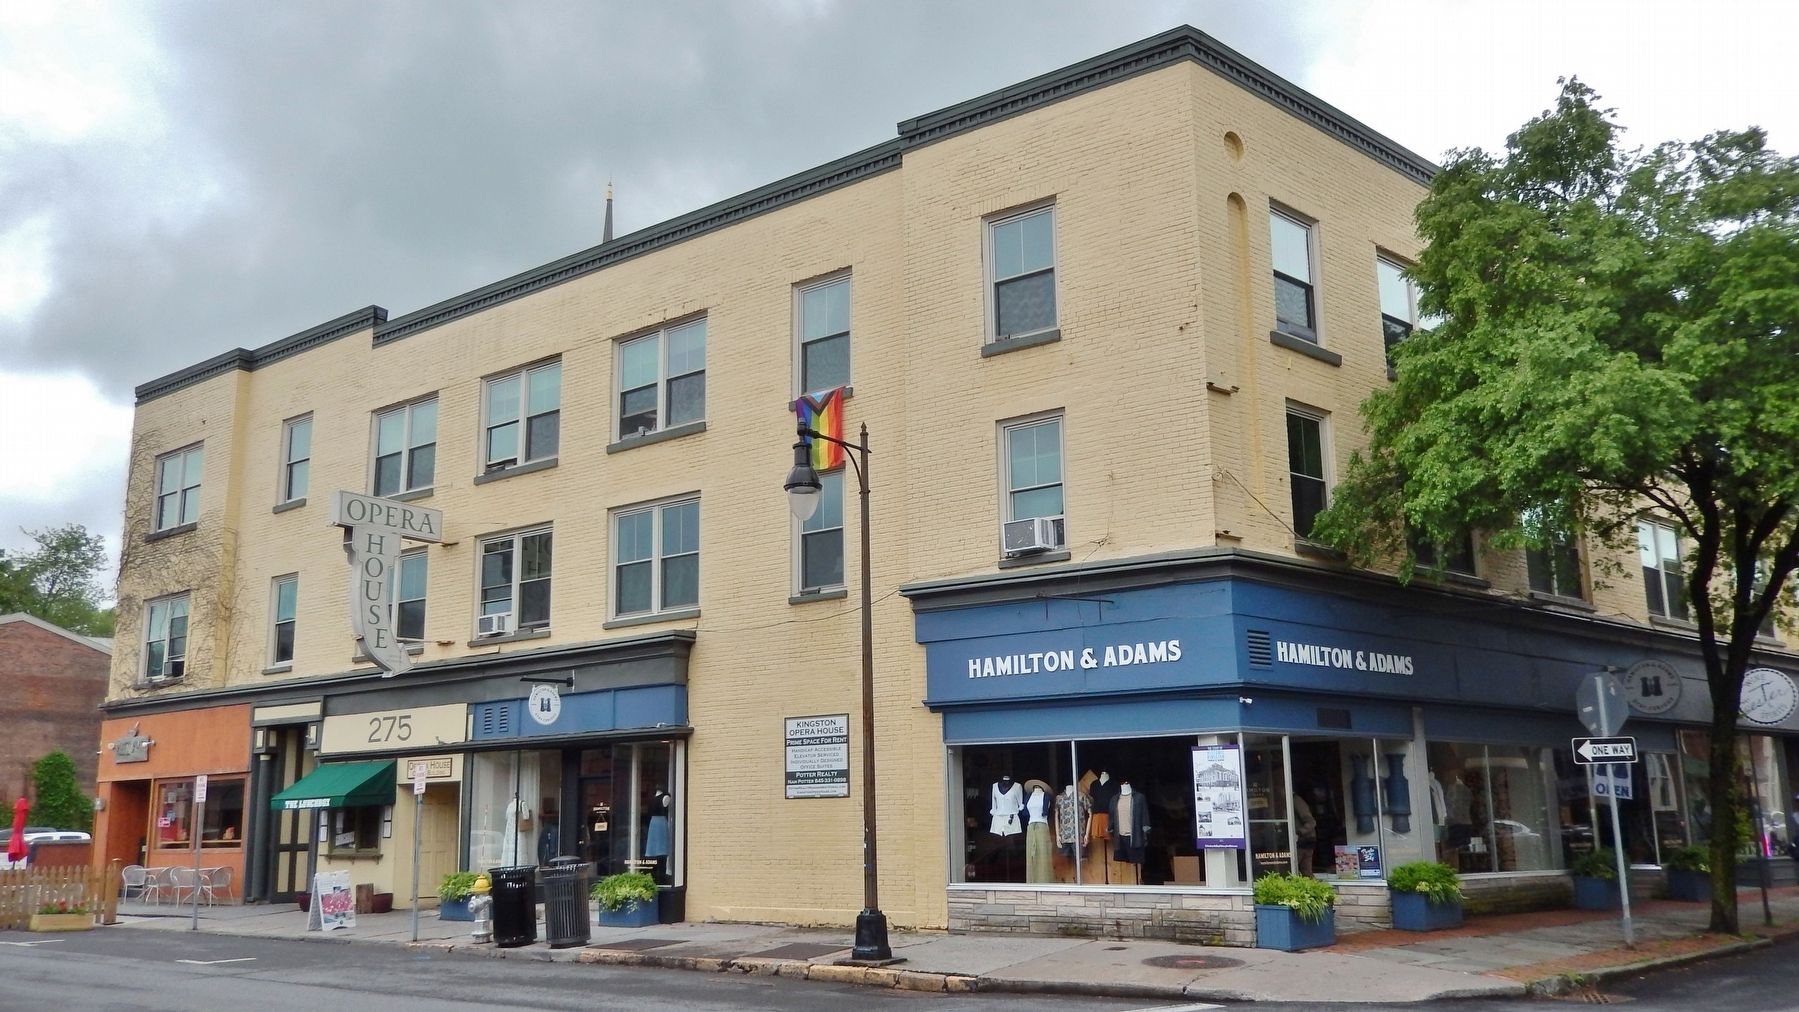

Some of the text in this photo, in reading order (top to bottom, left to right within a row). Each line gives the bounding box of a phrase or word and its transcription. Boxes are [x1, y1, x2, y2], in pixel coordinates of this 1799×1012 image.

[346, 499, 436, 534] OPERA
[364, 533, 388, 649] HOUSE
[968, 640, 1182, 679] HAMILTON & ADAMS
[1277, 641, 1414, 675] HAMILTON & ADAMS
[368, 715, 412, 743] 275
[796, 719, 837, 728] KINGSTON
[789, 726, 844, 736] OPERA HOUSE
[1592, 745, 1630, 755] ONE WAY
[431, 760, 450, 769] HOUSE
[1595, 783, 1630, 797] OEN
[285, 800, 298, 809] THE
[1255, 852, 1274, 860] HAMILTON
